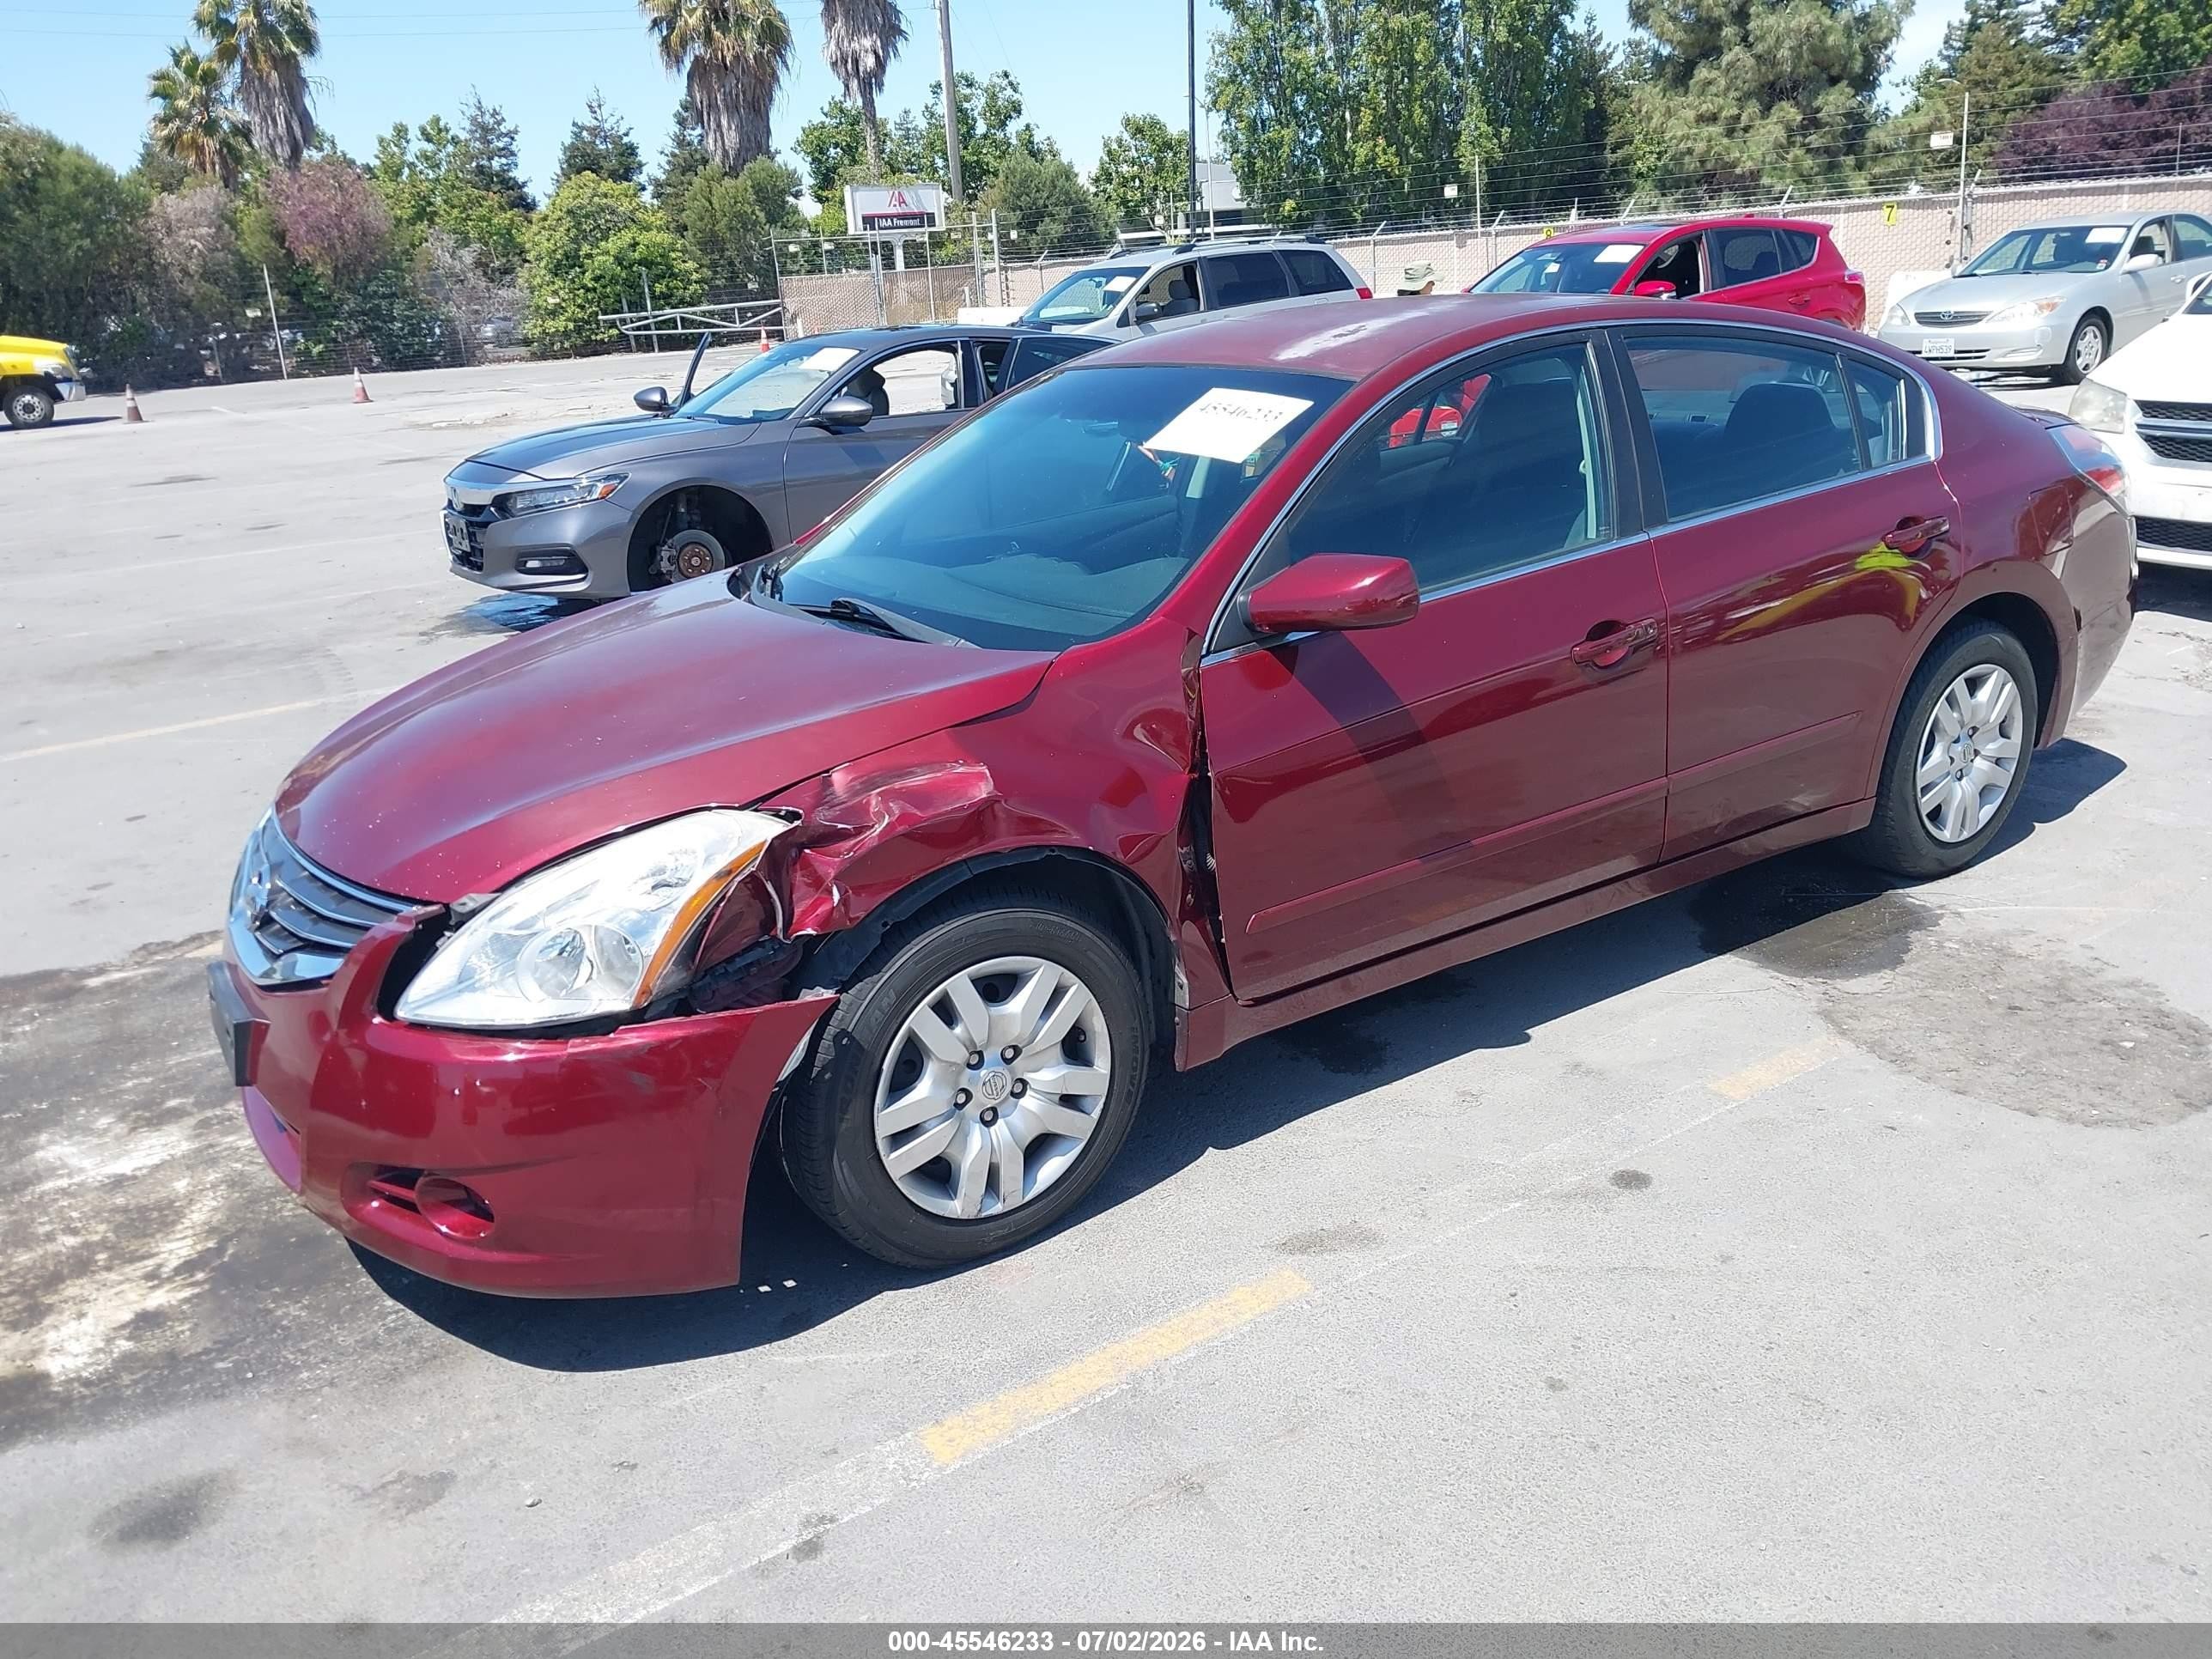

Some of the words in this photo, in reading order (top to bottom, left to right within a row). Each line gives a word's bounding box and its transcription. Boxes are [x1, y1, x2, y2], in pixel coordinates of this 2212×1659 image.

[1885, 204, 1895, 222] 7
[879, 219, 892, 228] IAA
[893, 218, 920, 228] Fremont
